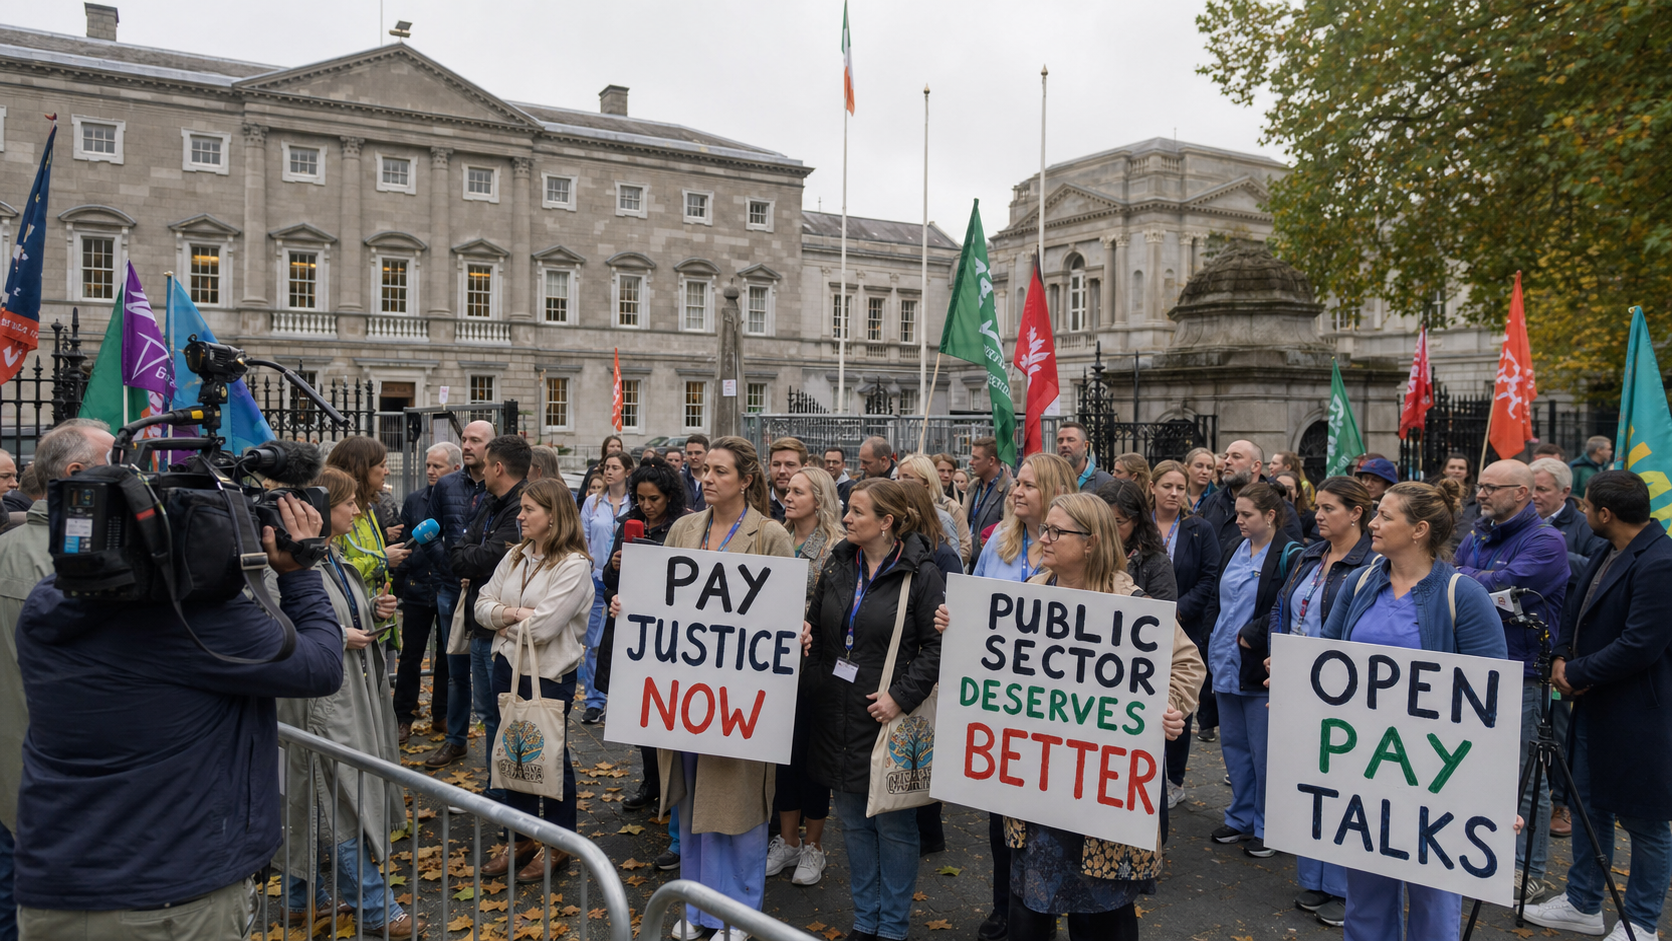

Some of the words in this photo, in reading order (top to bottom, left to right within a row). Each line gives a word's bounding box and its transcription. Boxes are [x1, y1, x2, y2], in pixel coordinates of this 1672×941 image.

[665, 555, 772, 615] PAY
[626, 613, 797, 675] JUSTICE
[988, 592, 1160, 652] PUBLIC
[981, 634, 1156, 696] SECTOR
[1310, 649, 1500, 728] OPEN
[639, 676, 767, 740] NOW
[959, 676, 1146, 736] DESERVES
[964, 722, 1157, 815] BETTER
[1318, 717, 1473, 794] PAY
[1297, 782, 1498, 879] TALKS
